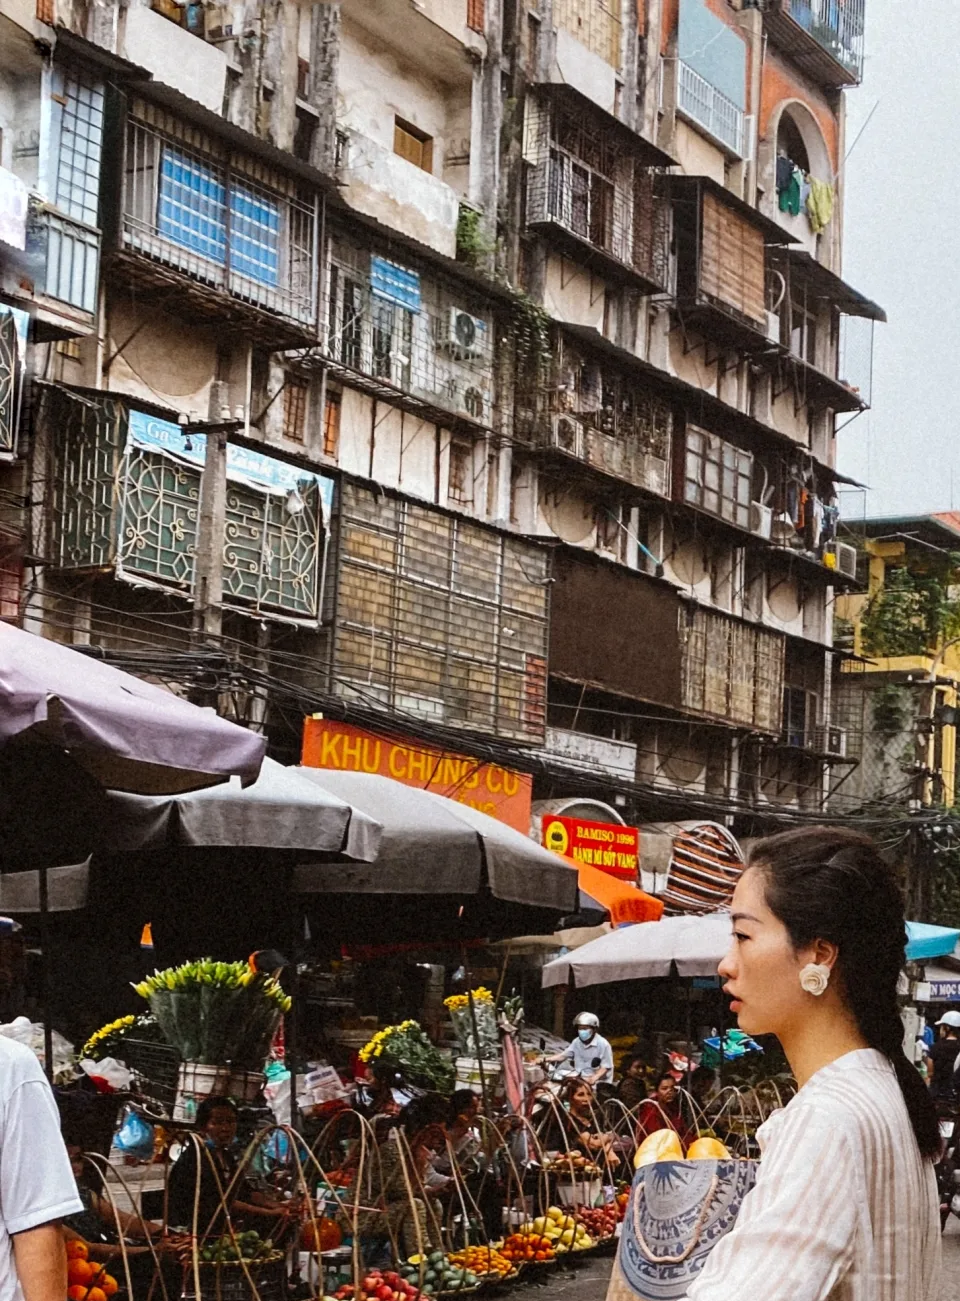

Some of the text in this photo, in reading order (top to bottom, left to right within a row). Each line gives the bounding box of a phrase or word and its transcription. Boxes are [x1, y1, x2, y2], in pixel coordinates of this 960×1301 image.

[320, 731, 380, 774] KHU
[388, 743, 480, 789] CHUNG
[576, 826, 614, 843] BAMISO
[616, 852, 637, 869] VANG
